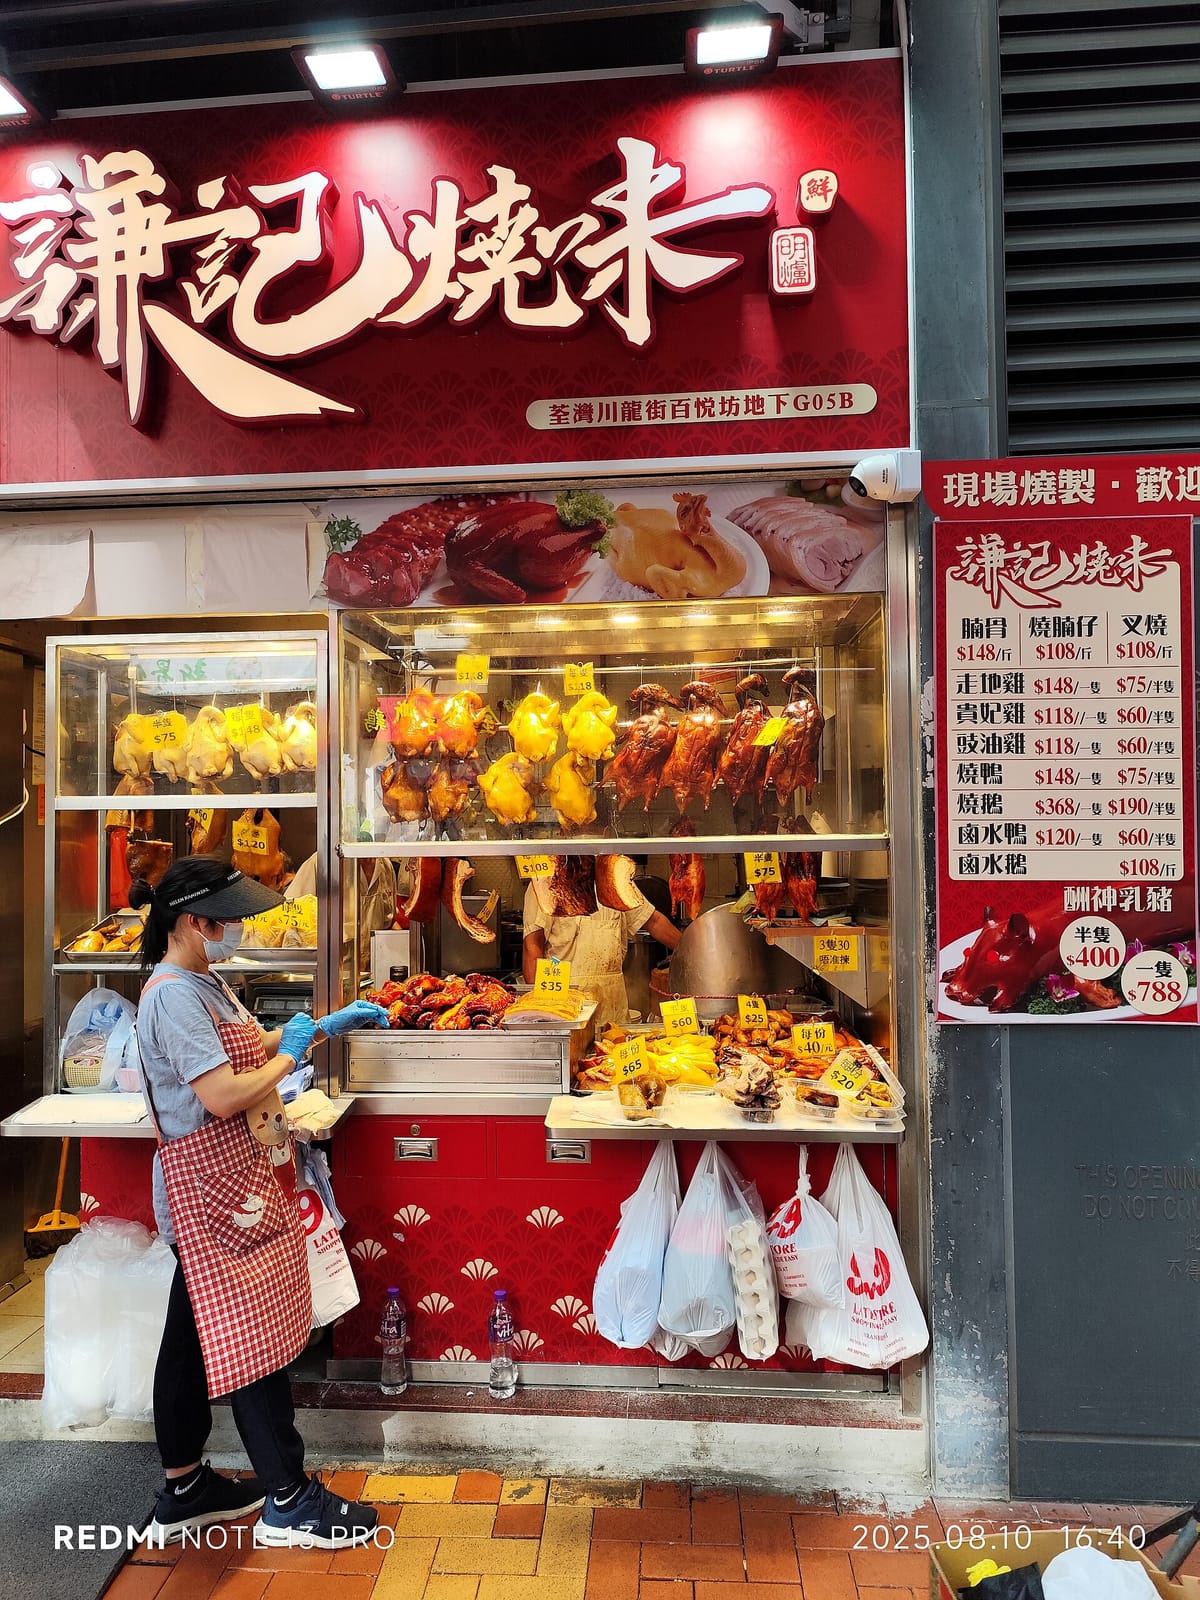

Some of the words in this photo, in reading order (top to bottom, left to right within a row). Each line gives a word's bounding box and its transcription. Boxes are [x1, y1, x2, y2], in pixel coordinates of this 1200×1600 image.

[714, 64, 759, 74] TURTLE
[341, 91, 384, 100] TURTLE
[806, 176, 833, 203] 鮮
[780, 233, 808, 286] 明爐
[951, 533, 1173, 608] 謙記燒味
[961, 617, 1007, 639] 腩骨
[1029, 615, 1098, 638] 燒腩仔
[1121, 614, 1168, 637] 叉燒
[956, 672, 1025, 695] 走地雞
[956, 702, 1025, 725] 貴妃雞
[154, 731, 176, 744] $75
[956, 732, 1026, 755] 豉油雞
[957, 762, 1003, 785] 燒鴨
[957, 792, 1003, 815] 燒鵝
[236, 838, 265, 850] $120
[958, 823, 1027, 845] 鹵水鴨
[522, 862, 549, 873] $108
[754, 867, 776, 878] $75
[958, 853, 1027, 875] 鹵水鵝
[1063, 885, 1173, 913] 酬神乳豬
[1074, 926, 1111, 944] 半隻
[1066, 946, 1120, 968] $400
[1136, 960, 1173, 978] 一隻
[540, 981, 562, 992] $35
[1128, 981, 1182, 1002] $788
[671, 1016, 692, 1029] $60
[745, 1014, 764, 1024] $25
[801, 1027, 826, 1039] 每份
[622, 1058, 642, 1077] $65
[830, 1070, 855, 1090] $20
[1074, 1164, 1118, 1188] THIS
[1123, 1165, 1200, 1190] OPENIN
[1082, 1194, 1112, 1219] DO
[1118, 1195, 1159, 1220] NOT
